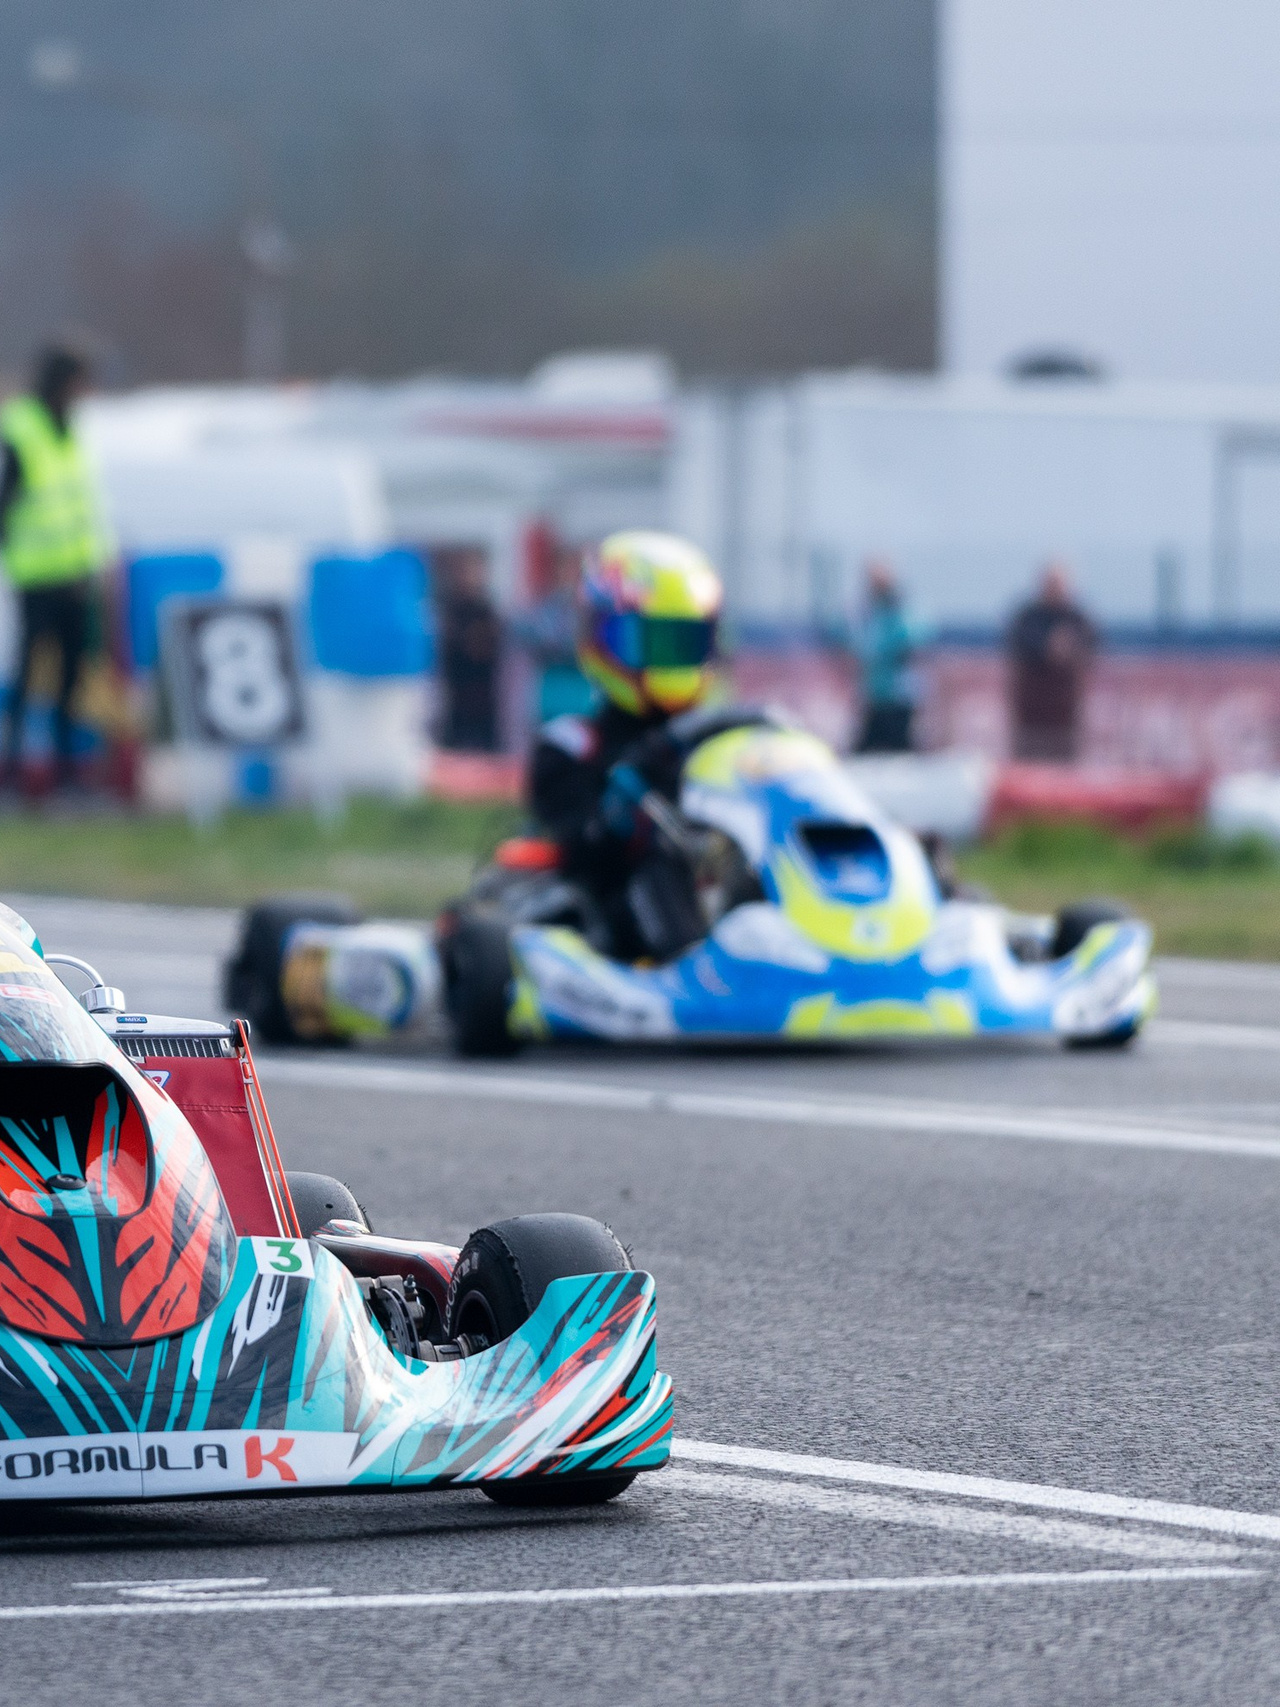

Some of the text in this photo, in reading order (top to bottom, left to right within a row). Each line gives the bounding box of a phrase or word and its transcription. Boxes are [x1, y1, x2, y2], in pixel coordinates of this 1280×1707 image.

[201, 615, 289, 742] 8
[267, 1241, 303, 1273] 3
[244, 1436, 299, 1482] K
